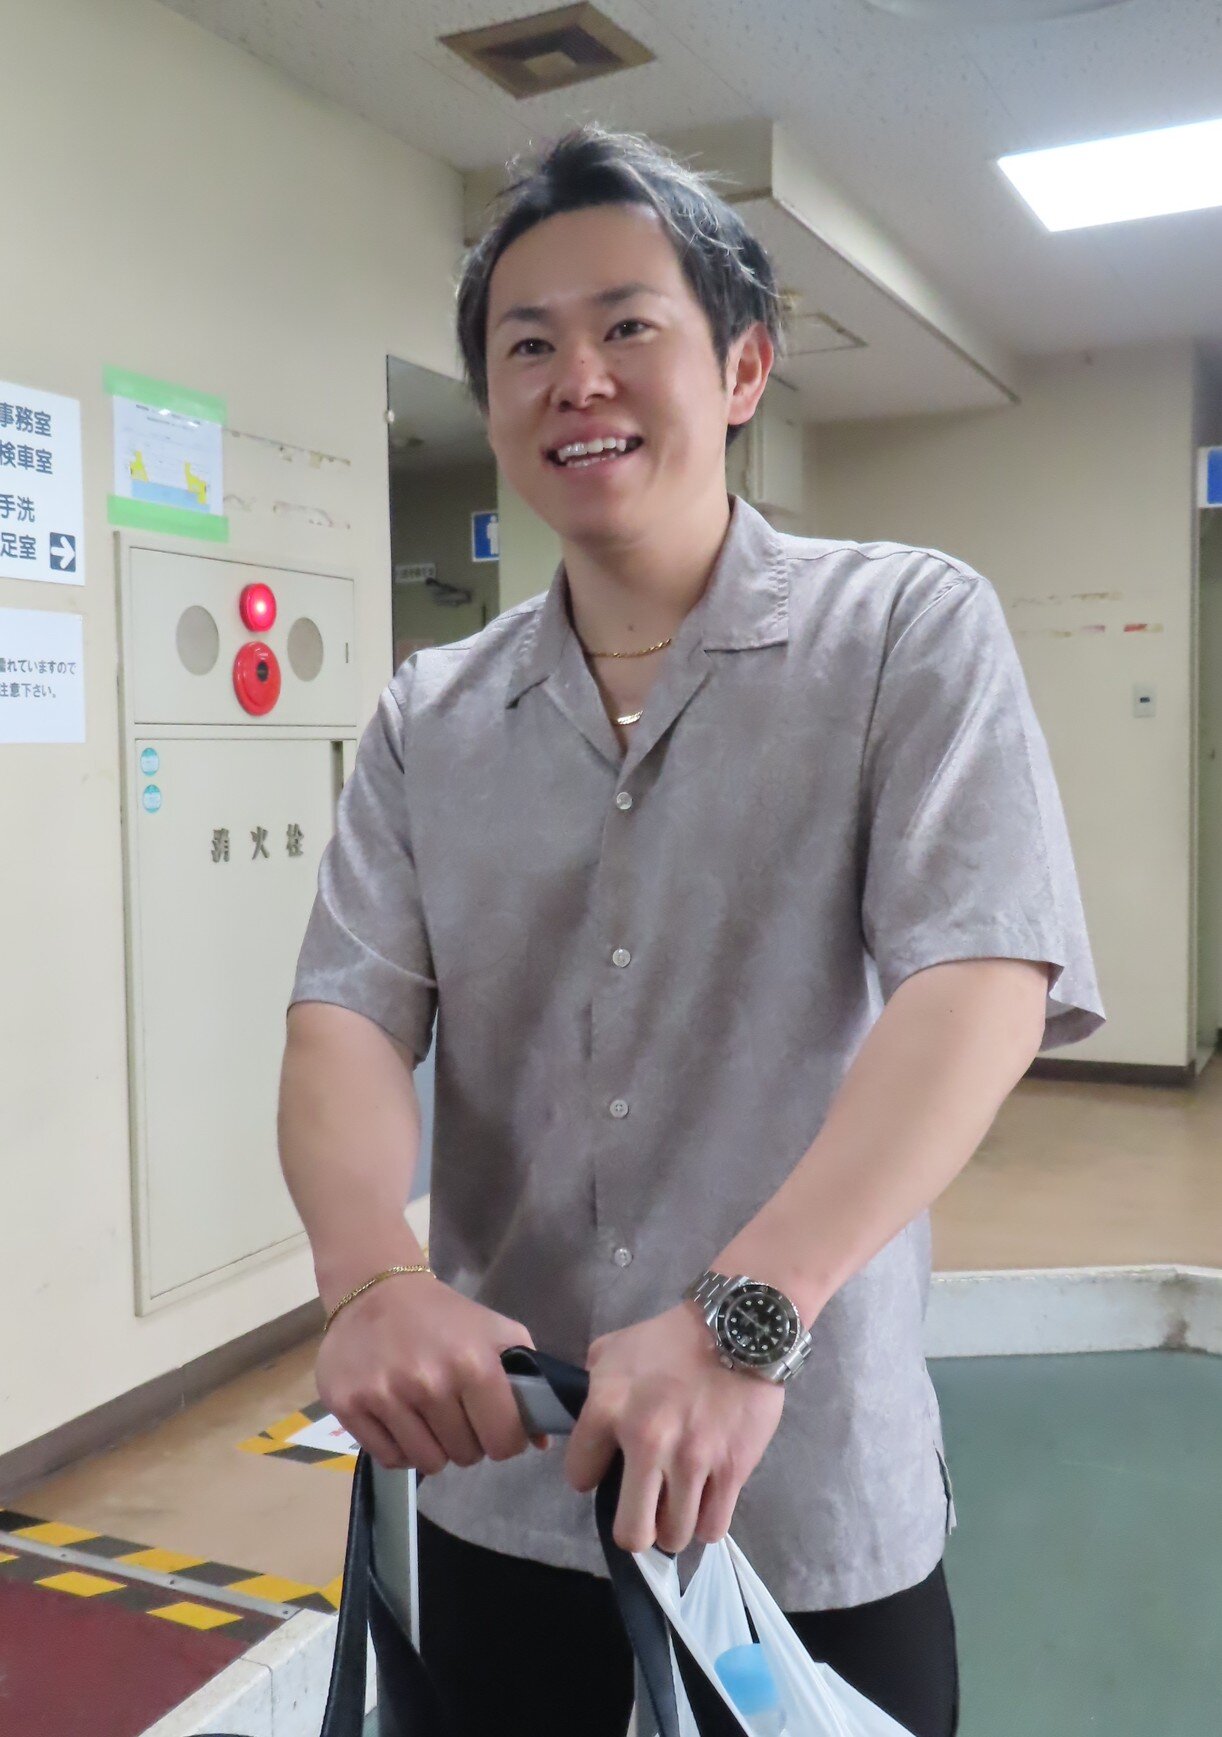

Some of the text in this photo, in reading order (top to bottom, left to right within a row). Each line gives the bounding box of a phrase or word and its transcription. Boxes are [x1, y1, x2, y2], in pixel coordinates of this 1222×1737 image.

[0, 402, 52, 437] 事務室
[0, 440, 53, 474] 検車室
